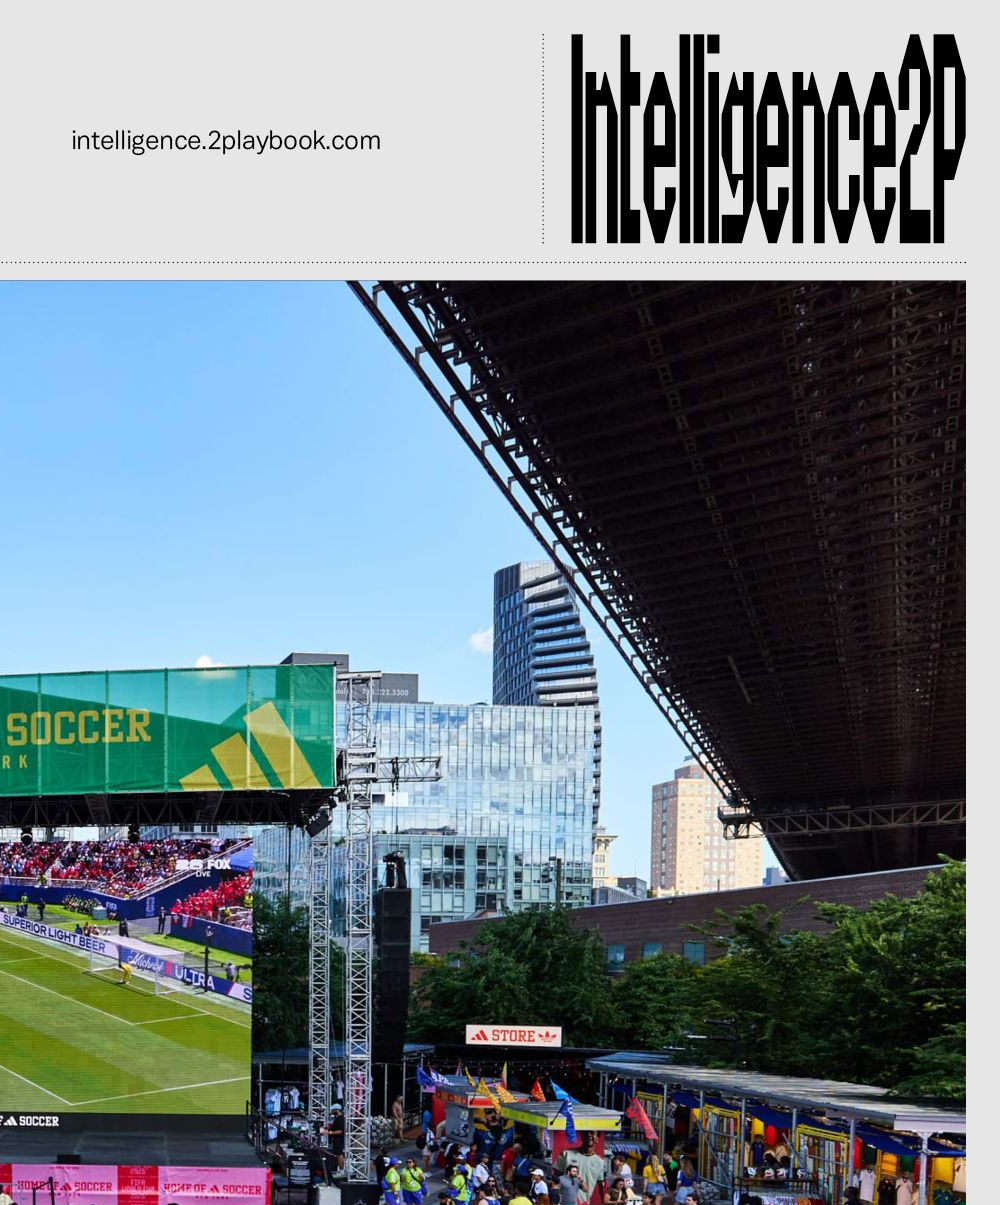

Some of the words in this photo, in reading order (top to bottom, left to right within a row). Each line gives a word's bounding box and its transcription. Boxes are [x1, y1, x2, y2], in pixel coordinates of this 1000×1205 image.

[7, 708, 152, 747] SOCCER
[207, 858, 231, 870] FOX
[3, 914, 47, 936] SUPERIOR
[48, 927, 78, 945] LIGHT
[79, 936, 106, 953] BEER
[175, 965, 215, 990] ULTRA
[491, 1029, 536, 1042] STORE
[19, 1115, 59, 1127] SOCCER
[75, 1181, 113, 1192] SOCCER
[163, 1183, 192, 1193] HOME
[194, 1183, 206, 1193] OF
[223, 1184, 262, 1195] SOCCER
